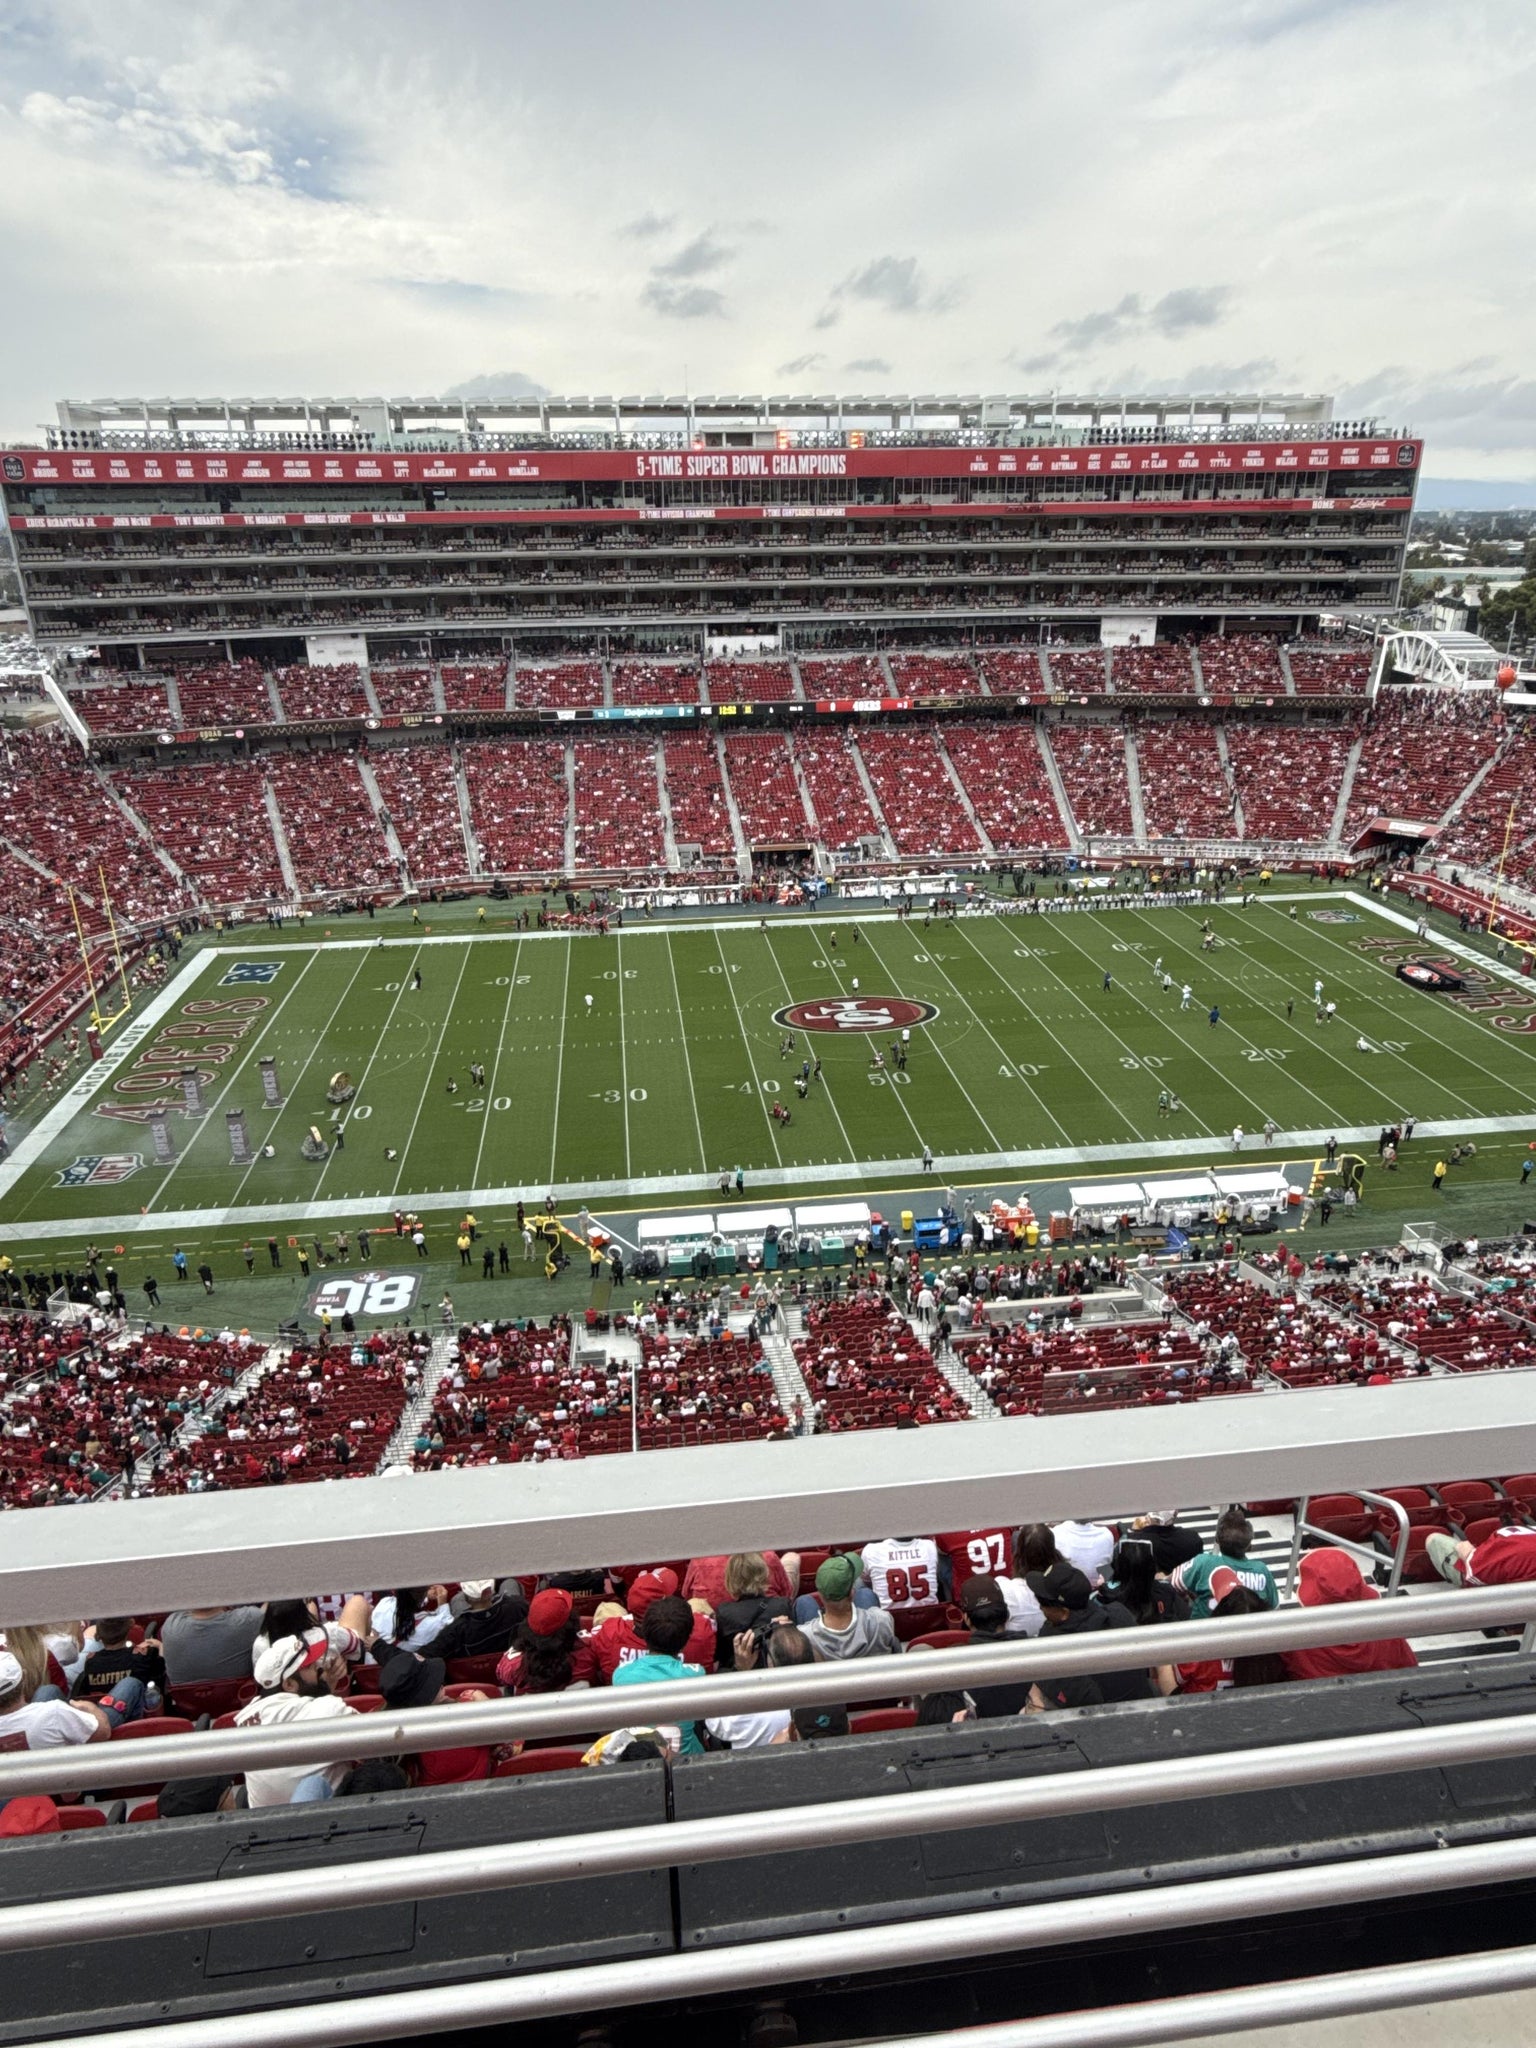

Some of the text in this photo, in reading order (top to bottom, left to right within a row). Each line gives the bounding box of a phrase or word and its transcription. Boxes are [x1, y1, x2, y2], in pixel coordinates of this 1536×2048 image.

[637, 455, 846, 476] 5-TIME SUPER BOWL CHAMPIONS
[1312, 500, 1334, 509] HOME
[624, 708, 663, 717] Dolphins
[71, 1021, 152, 1097] CHOOSE LOVE
[91, 996, 272, 1125] 49ERS
[1119, 1056, 1163, 1069] 30
[1241, 1048, 1286, 1062] 20
[998, 1064, 1039, 1077] 40
[867, 1072, 911, 1086] 50
[739, 1080, 780, 1094] 40
[604, 1088, 648, 1103] 30
[466, 1097, 511, 1112] 20
[327, 1106, 372, 1121] 10
[88, 1155, 135, 1182] NFL
[888, 1549, 921, 1561] KITTLE
[967, 1533, 1007, 1575] 97
[886, 1565, 930, 1602] 85
[1236, 1571, 1267, 1591] RINO
